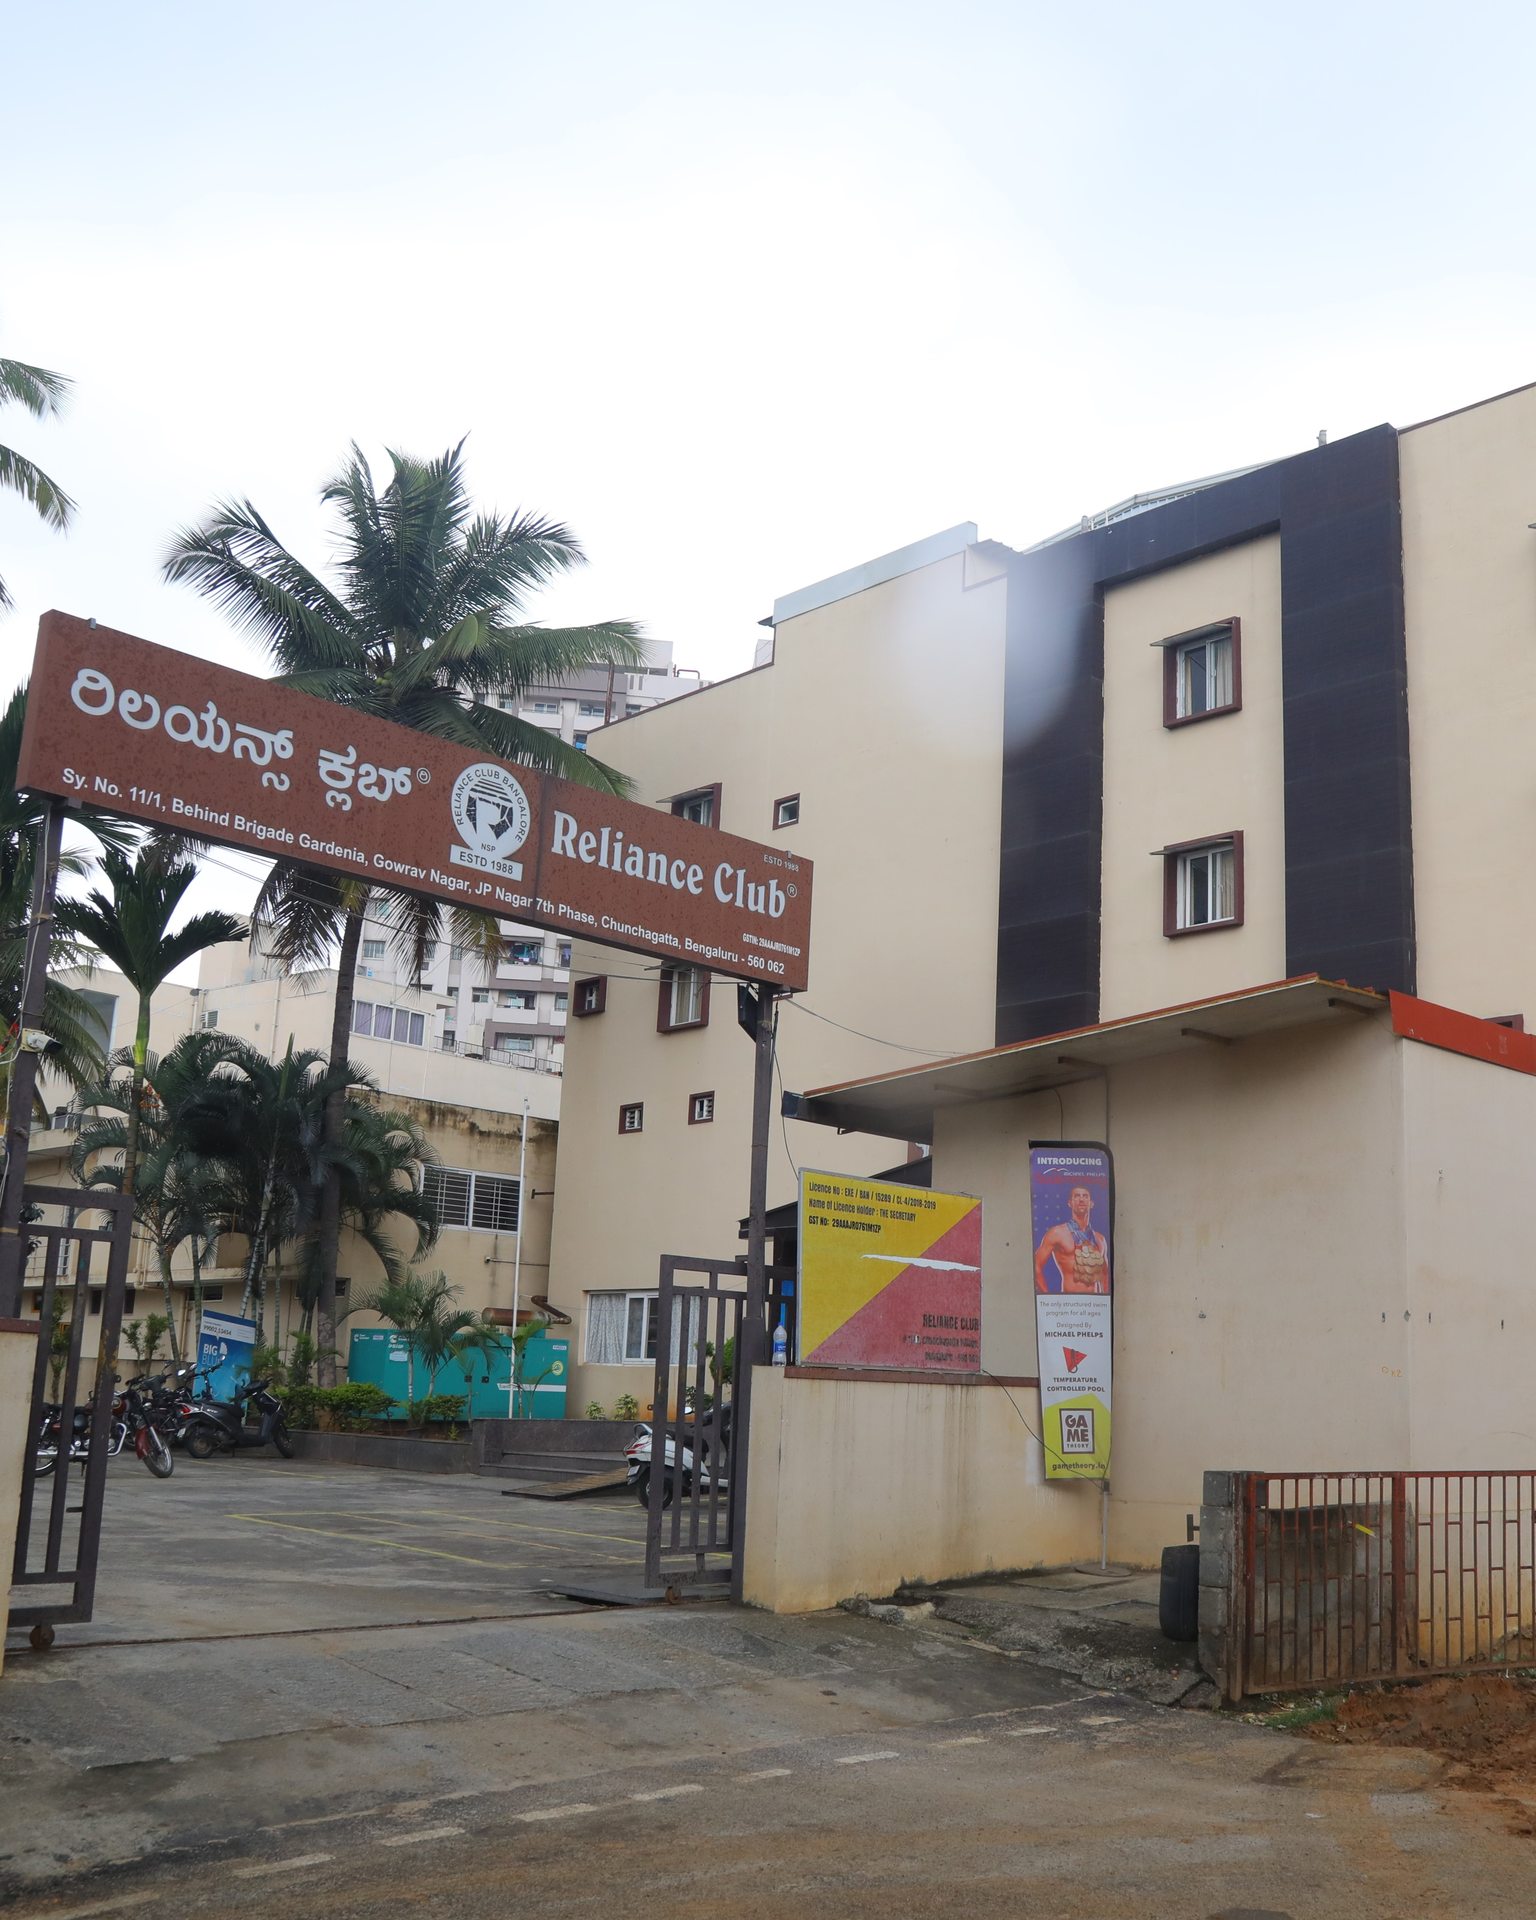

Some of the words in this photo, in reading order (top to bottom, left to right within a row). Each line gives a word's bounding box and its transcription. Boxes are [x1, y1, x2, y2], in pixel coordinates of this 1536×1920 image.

[318, 745, 411, 811] ಕ್ಲಬ್
[455, 773, 474, 826] RELIANCE
[475, 769, 500, 779] CLUB
[502, 776, 527, 843] BANGALORE
[481, 843, 496, 852] NSP
[460, 851, 487, 867] ESTD
[491, 860, 513, 874] 1988
[551, 810, 703, 895] Reliance
[713, 862, 786, 918] Club
[764, 854, 782, 866] ESTD
[784, 861, 799, 872] 1988
[62, 768, 88, 790] Sy.
[94, 776, 123, 797] No.
[129, 787, 166, 812] 11/1,
[172, 798, 230, 826] Behind
[234, 815, 294, 844] Brigade
[299, 833, 368, 866] Gardenia,
[373, 853, 426, 880] Gowrav
[430, 869, 472, 894] Nagar,
[475, 881, 492, 896] JP
[495, 887, 533, 907] Nagar
[535, 898, 555, 915] 7th
[558, 903, 598, 927] Phase,
[601, 915, 681, 949] Chunchagatta,
[685, 938, 738, 962] Bengaluru
[747, 955, 764, 969] 560
[767, 961, 785, 974] 062
[1037, 1157, 1102, 1166] INTRODUCING
[809, 1182, 831, 1194] Licence
[809, 1198, 825, 1209] Name
[833, 1201, 855, 1213] Licence
[856, 1204, 875, 1216] Holder
[880, 1208, 888, 1219] THE
[889, 1210, 916, 1222] SECRETARY
[808, 1215, 818, 1225] GST
[922, 1313, 959, 1330] RELIANCE
[960, 1317, 979, 1331] CLUB
[203, 1343, 218, 1356] BIG
[202, 1354, 223, 1366] BLU
[1065, 1415, 1088, 1428] GA
[1067, 1429, 1089, 1442] ME
[1052, 1462, 1105, 1471] gametheory.in
